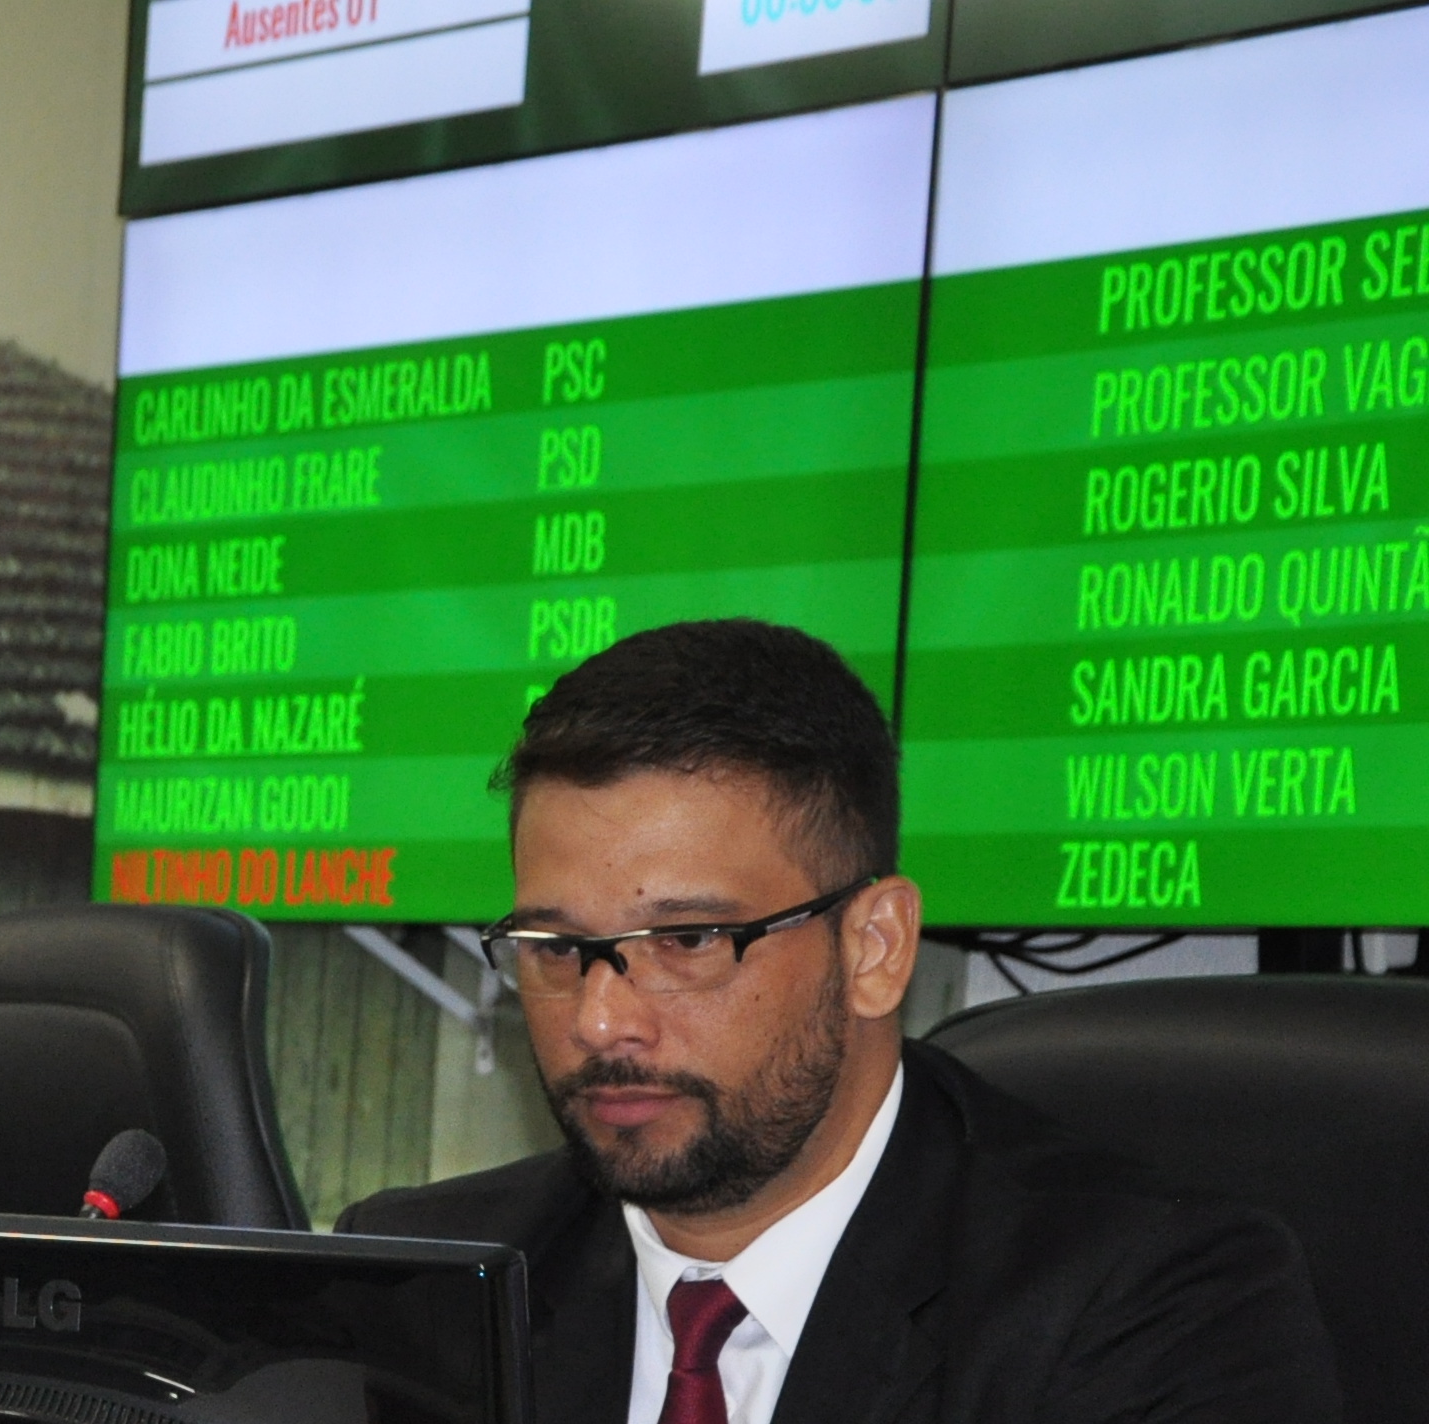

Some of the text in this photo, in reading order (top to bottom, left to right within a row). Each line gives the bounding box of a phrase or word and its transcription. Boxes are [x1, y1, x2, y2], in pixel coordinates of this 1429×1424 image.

[224, 0, 339, 49] Ausentes
[1098, 236, 1347, 334] PROFESSOR
[134, 338, 607, 447] CARLINHO DA ESMERALDA PSC
[1091, 347, 1328, 438] PROFESSOR
[130, 425, 602, 525] CLAUDINHO FRARE PSD
[1083, 442, 1389, 536] ROGERIO SILVA
[126, 511, 606, 602] DONA NEIDE MDB
[1077, 552, 1266, 631] RONALDO
[123, 620, 204, 678] FABIO
[210, 615, 297, 676] BRITO
[1070, 643, 1401, 727] SANDRA GARCIA
[117, 675, 366, 758] HÉLIO DA NAZARÉ
[114, 774, 350, 834] MAURIZAN GODOI
[1066, 746, 1357, 820] WILSON VERTA
[111, 847, 396, 906] NILTINHO DO LANCHE
[1055, 840, 1201, 908] ZEDECA
[3, 1277, 82, 1332] LG
